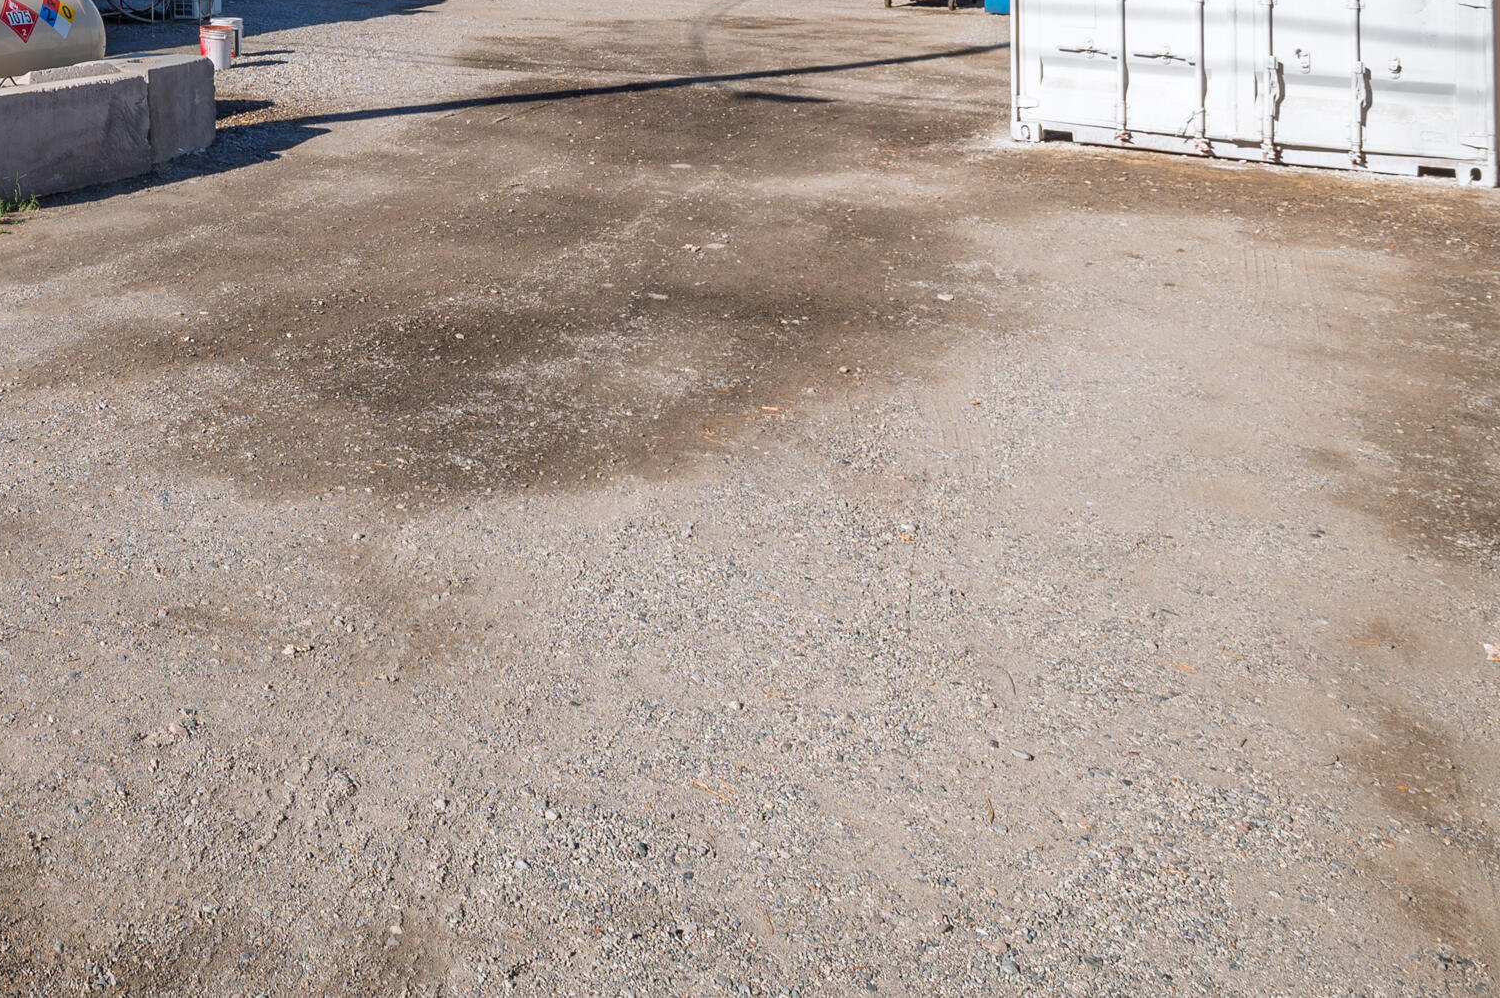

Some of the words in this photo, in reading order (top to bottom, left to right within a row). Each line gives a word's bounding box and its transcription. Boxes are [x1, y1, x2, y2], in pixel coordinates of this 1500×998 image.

[8, 11, 32, 24] 1075
[43, 7, 54, 20] 2
[62, 5, 72, 19] 0
